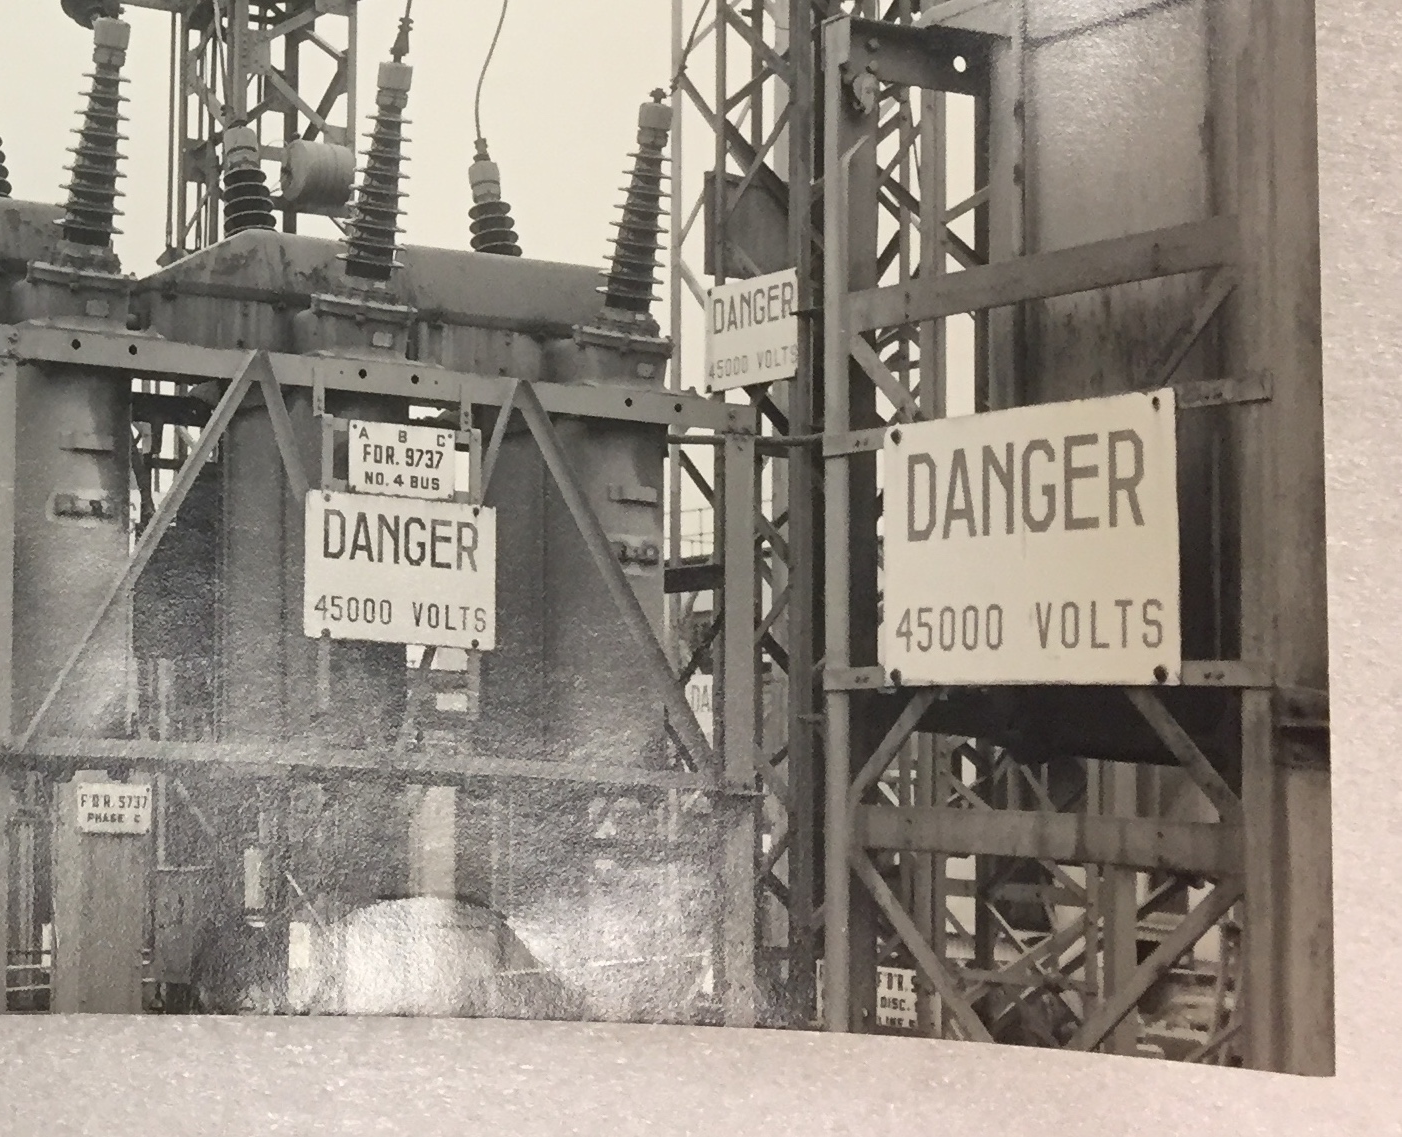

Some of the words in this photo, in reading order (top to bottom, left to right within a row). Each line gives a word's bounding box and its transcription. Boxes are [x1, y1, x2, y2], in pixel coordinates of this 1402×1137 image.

[713, 281, 793, 334] DANGER
[709, 355, 748, 379] 45000
[756, 344, 798, 369] VOLTS
[358, 426, 369, 440] A
[398, 430, 407, 443] B
[436, 434, 445, 447] C
[405, 448, 444, 469] 9737
[393, 474, 404, 487] 4
[410, 475, 440, 491] BUS
[907, 428, 1145, 542] DANGER
[323, 508, 479, 572] DANGER
[314, 595, 392, 625] 45000
[411, 601, 487, 633] VOLTS
[895, 603, 1004, 653] 45000
[1035, 598, 1163, 649] VOLTS
[87, 811, 125, 824] PHASE
